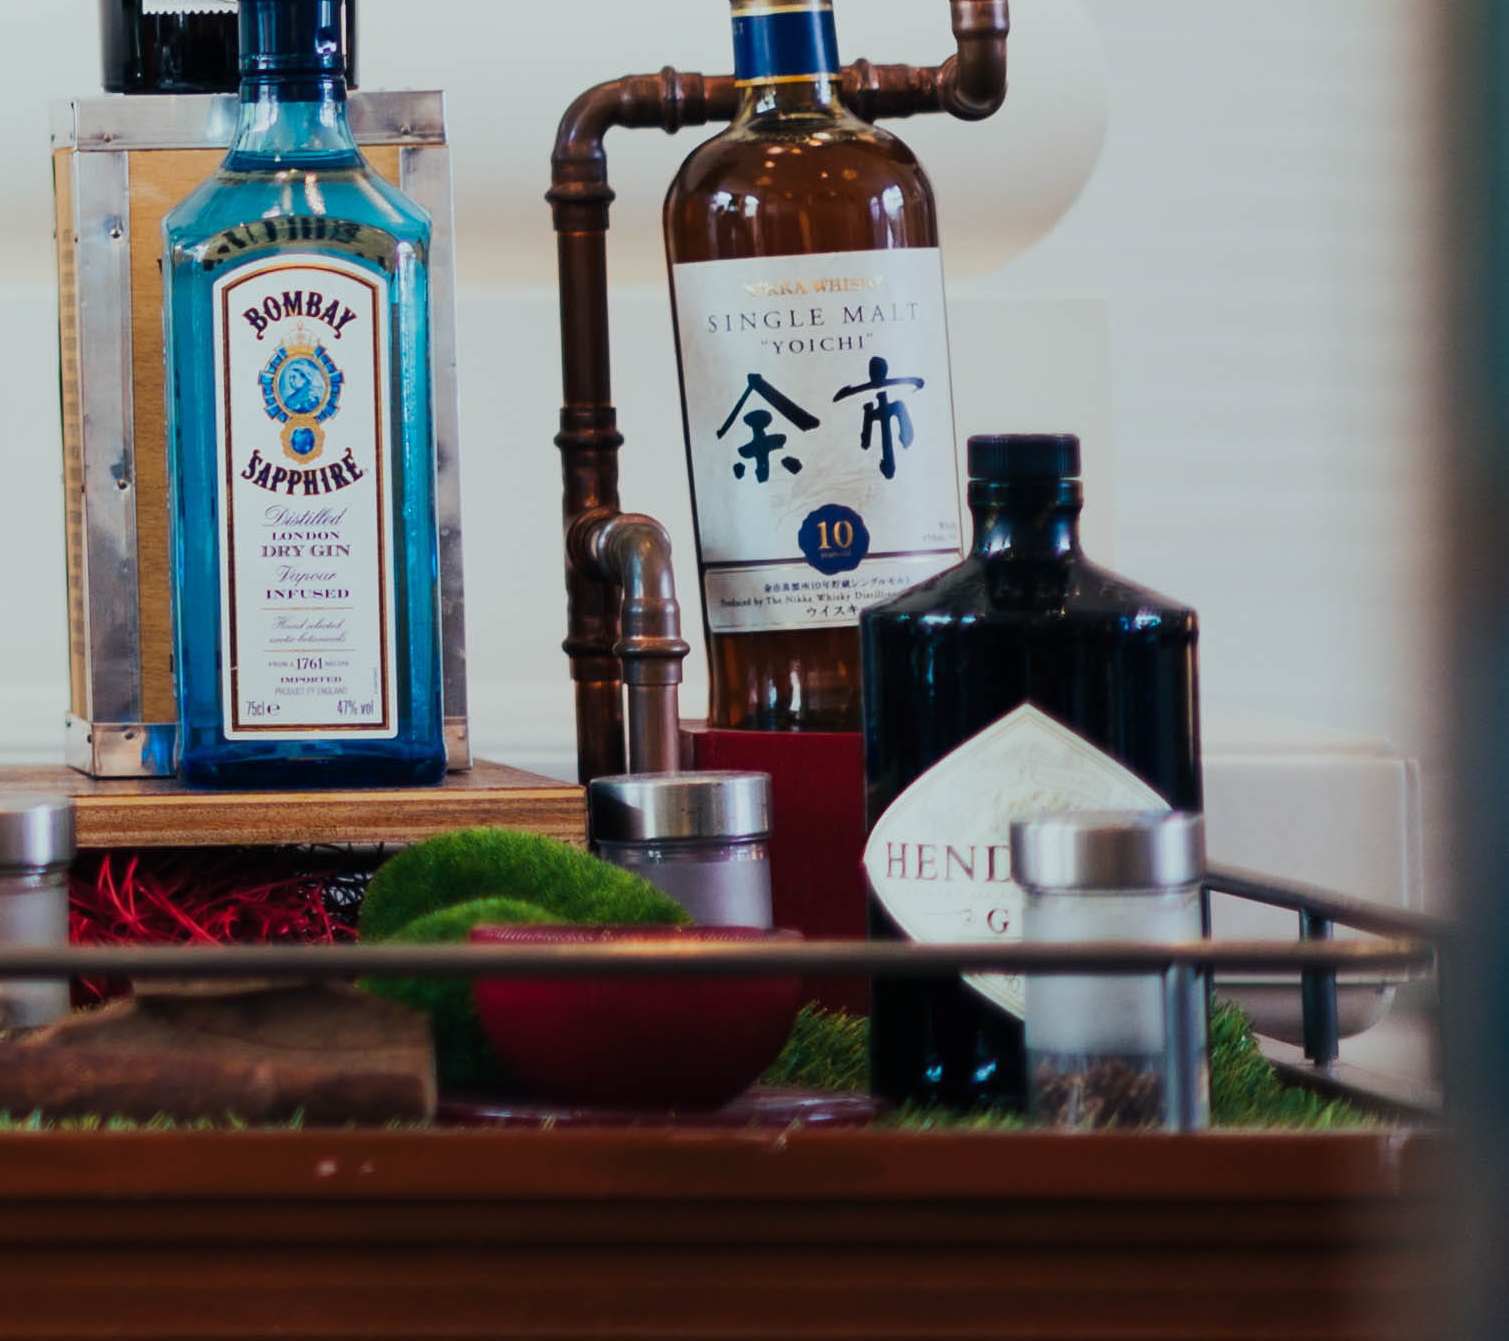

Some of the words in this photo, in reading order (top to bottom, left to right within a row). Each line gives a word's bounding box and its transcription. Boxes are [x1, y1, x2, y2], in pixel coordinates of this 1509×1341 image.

[242, 290, 357, 341] BOMBAY
[707, 308, 825, 334] SINGLE
[843, 301, 920, 325] MALT
[716, 356, 926, 484] 余市
[240, 446, 364, 497] SAPPHIRE
[262, 504, 350, 527] Distilled
[271, 532, 340, 541] LONDON
[816, 520, 855, 550] 10
[261, 544, 305, 558] DRY
[310, 543, 351, 557] GIN
[276, 564, 337, 587] Vapour
[265, 588, 350, 600] INFUSED
[766, 596, 782, 605] The
[785, 595, 813, 604] Nikka
[816, 593, 851, 603] Whisky
[296, 657, 323, 670] 1761
[280, 676, 343, 684] IMPORTED
[246, 700, 265, 716] 75cl
[336, 700, 358, 715] 47%
[360, 700, 374, 715] vol
